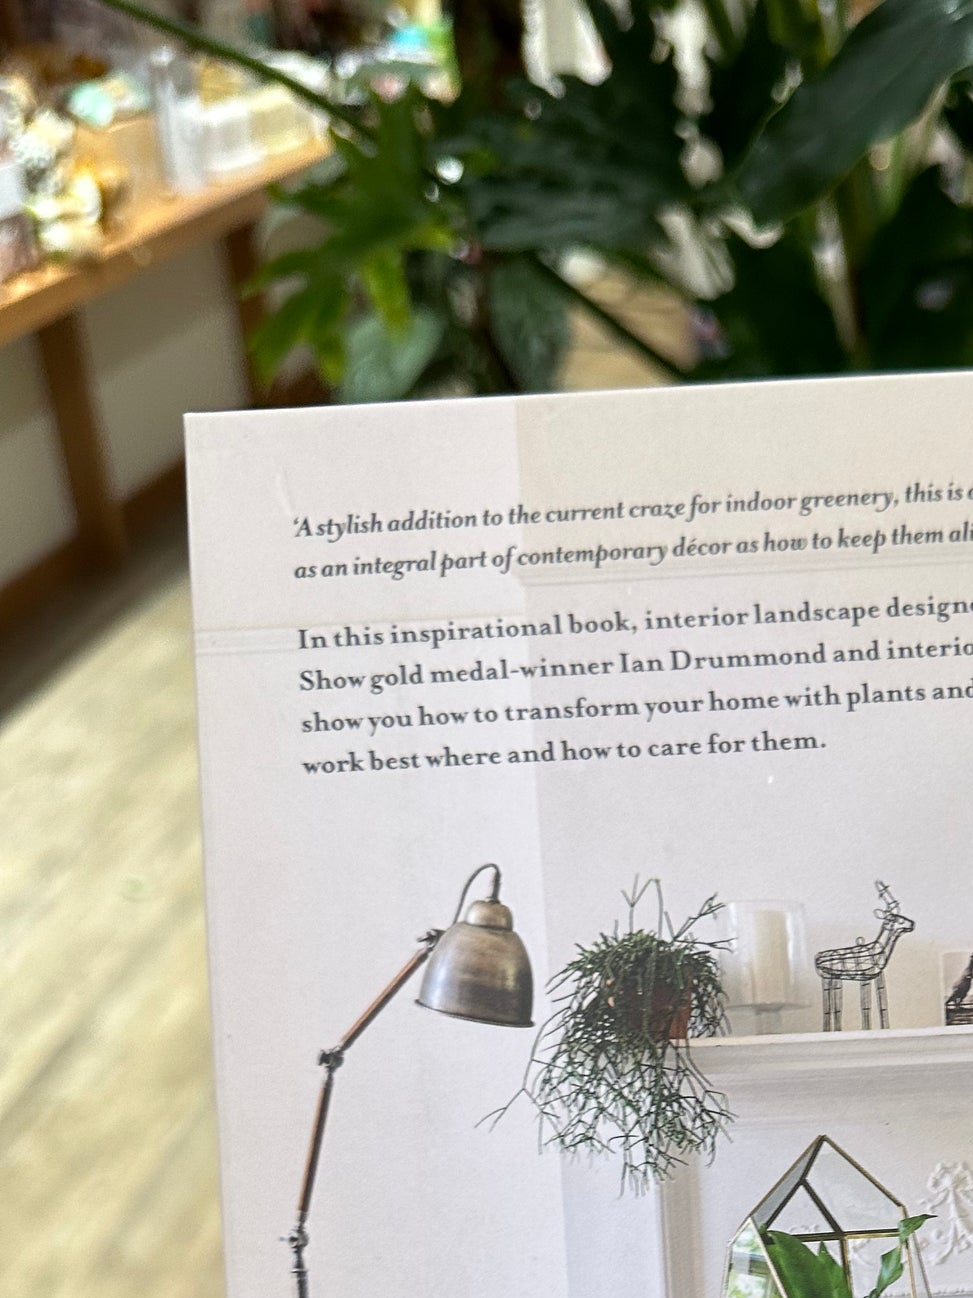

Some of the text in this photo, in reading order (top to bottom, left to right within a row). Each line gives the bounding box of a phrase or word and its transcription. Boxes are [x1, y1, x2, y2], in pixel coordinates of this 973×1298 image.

[314, 512, 384, 544] stylish
[386, 508, 478, 533] addition
[481, 509, 504, 527] to
[507, 503, 542, 526] the
[544, 501, 625, 524] current
[628, 500, 686, 522] craze
[684, 493, 723, 523] for
[725, 490, 797, 513] indoor
[798, 491, 900, 517] greenery,
[904, 481, 943, 504] this
[946, 481, 964, 502] is
[293, 565, 318, 579] as
[320, 563, 348, 578] an
[352, 549, 438, 581] integral
[439, 550, 488, 578] part
[490, 545, 518, 575] of
[518, 544, 669, 569] contemporary
[671, 535, 732, 558] décor
[735, 539, 760, 554] as
[762, 530, 808, 552] how
[811, 532, 834, 550] to
[837, 527, 888, 555] keep
[890, 523, 944, 546] them
[297, 628, 329, 650] In
[332, 625, 385, 648] this
[389, 613, 563, 650] inspirational
[567, 610, 638, 635] book,
[644, 606, 750, 630] interior
[752, 600, 881, 628] landscape
[299, 669, 367, 692] Show
[369, 663, 425, 696] gold
[429, 657, 615, 684] medal-winner
[619, 652, 665, 674] Ian
[669, 641, 827, 671] Drummond
[832, 639, 882, 663] and
[301, 711, 365, 734] show
[366, 714, 414, 737] you
[417, 704, 470, 727] how
[472, 707, 499, 724] to
[503, 696, 641, 722] transform
[644, 698, 705, 723] your
[707, 689, 780, 712] home
[784, 684, 842, 708] with
[845, 682, 927, 713] plants
[302, 729, 827, 776] work best where and how to care for them.
